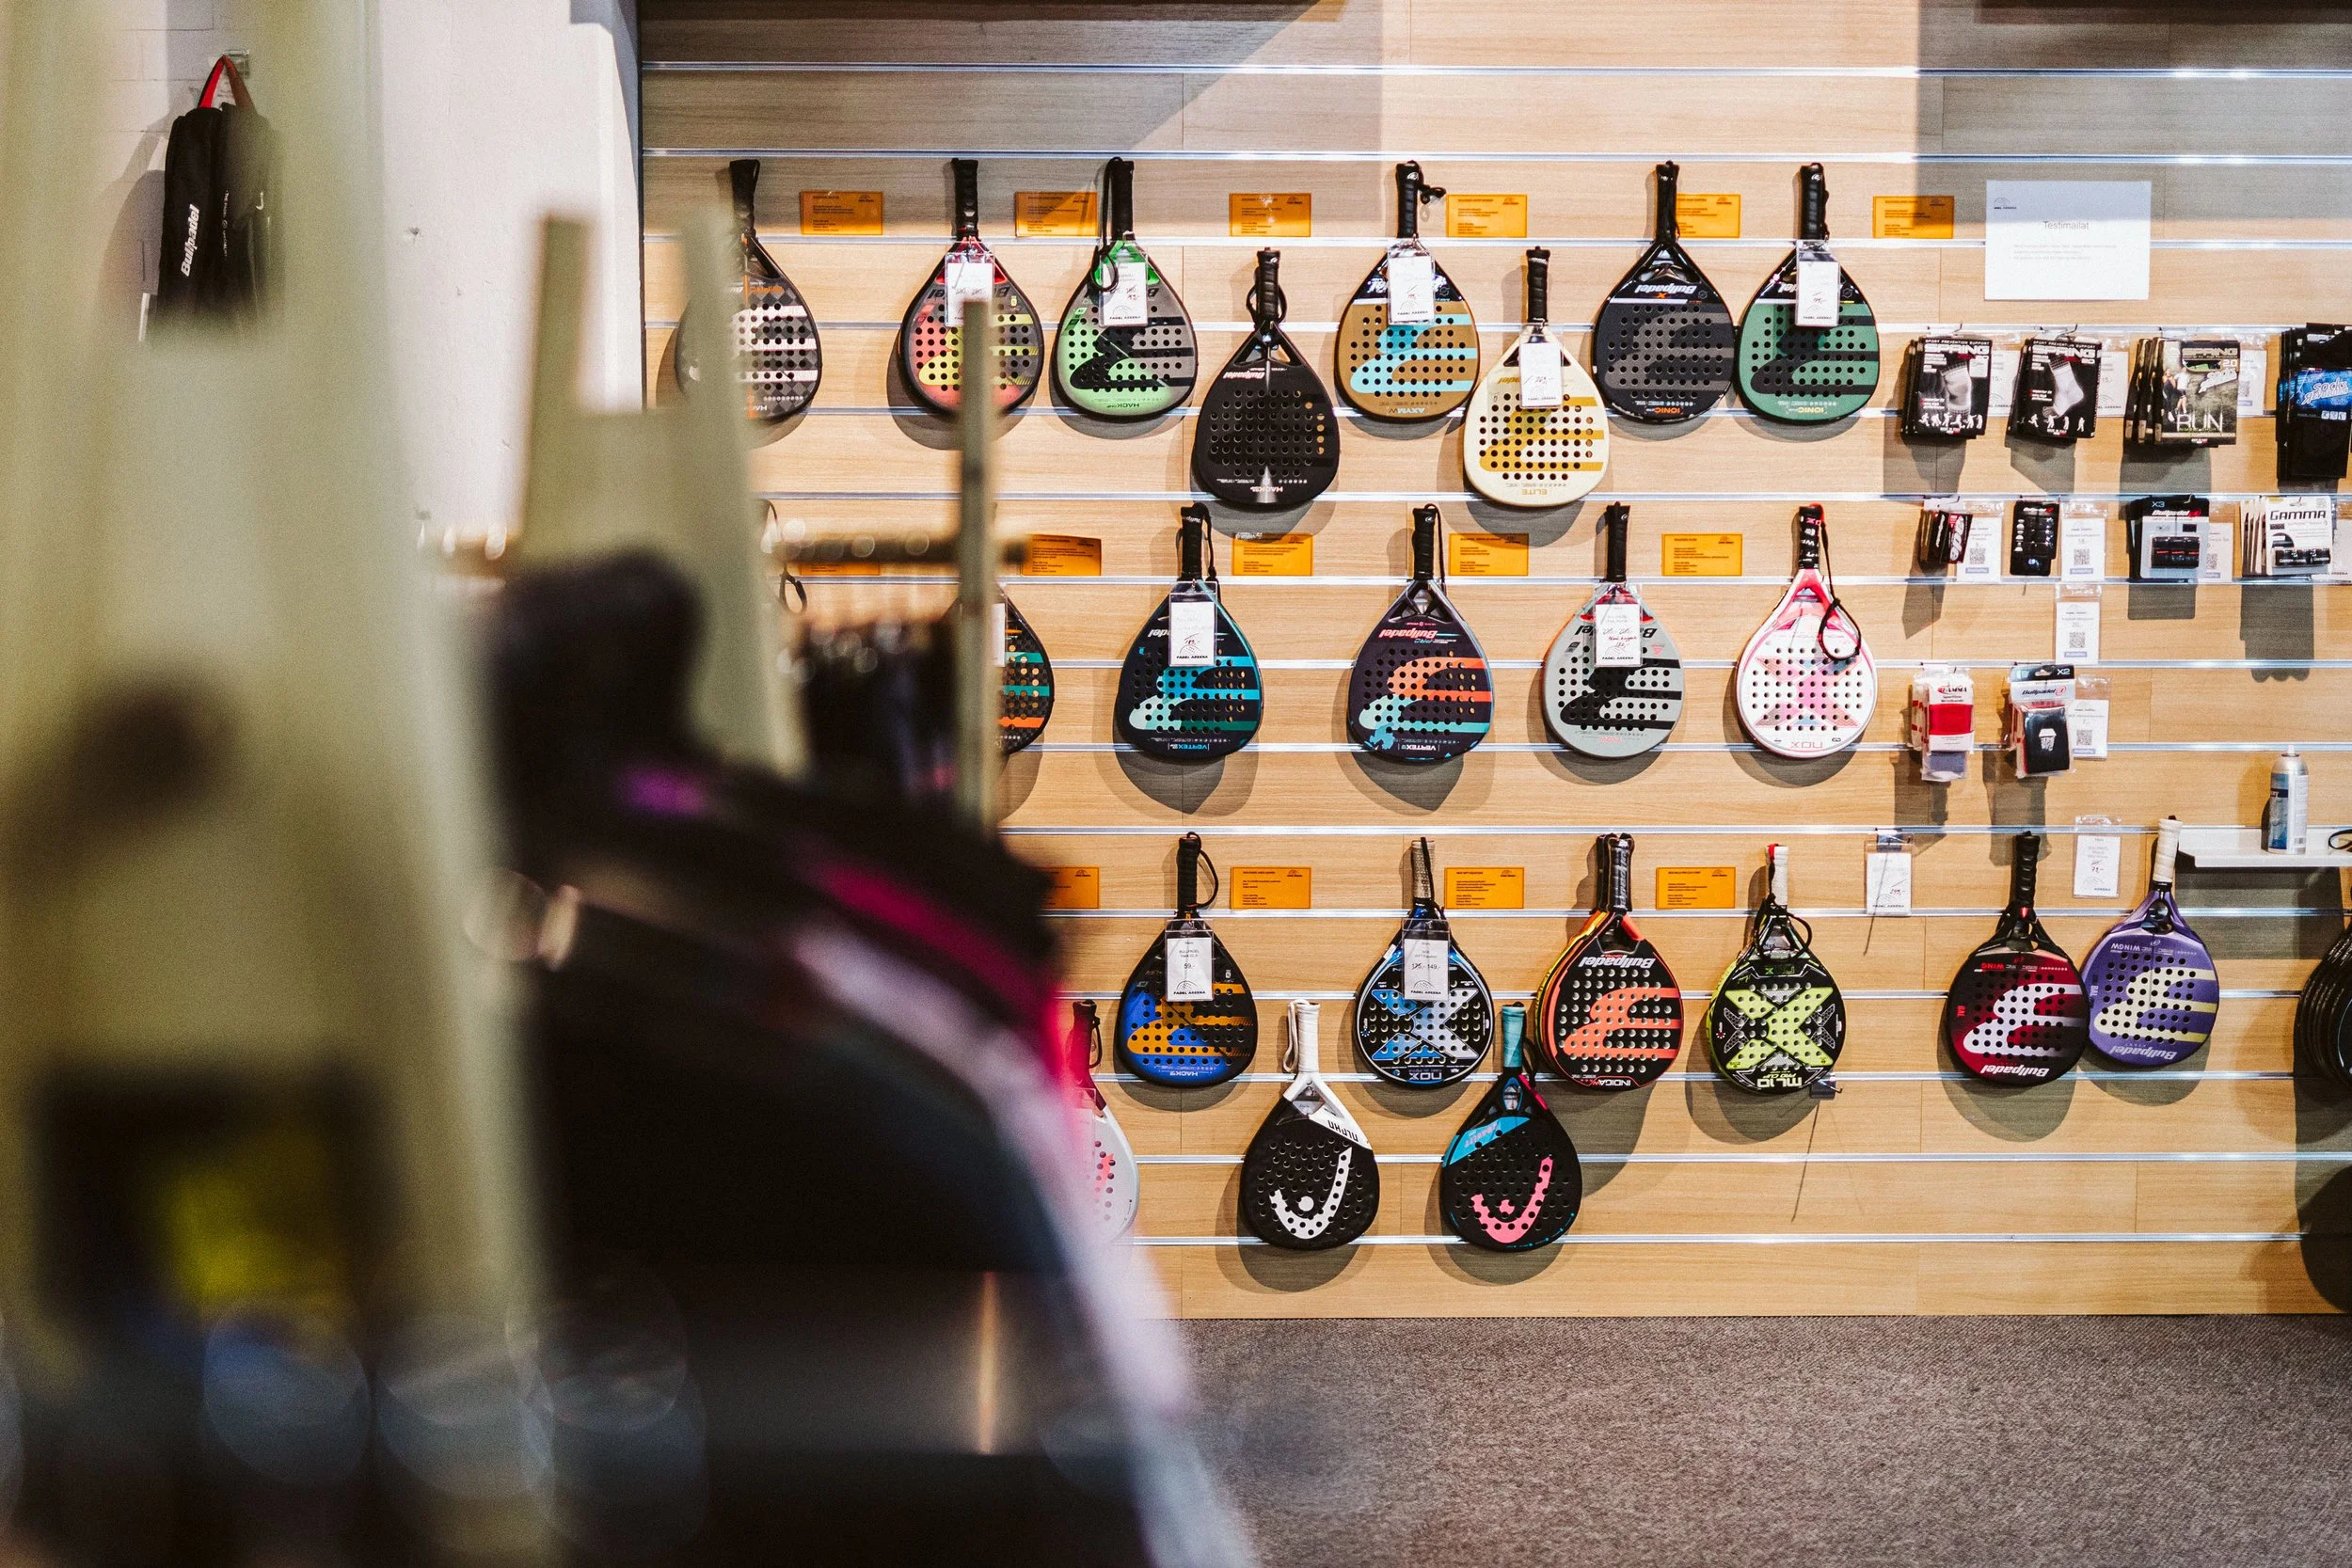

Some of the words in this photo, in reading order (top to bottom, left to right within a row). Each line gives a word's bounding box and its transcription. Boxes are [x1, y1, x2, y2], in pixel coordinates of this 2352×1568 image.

[2042, 220, 2090, 230] Testimailat
[181, 204, 199, 277] Bullpadel
[1634, 283, 1697, 294] Bullpadel
[1924, 343, 1990, 356] SPRING
[2033, 344, 2096, 357] SPRING
[1223, 370, 1265, 380] Bullpadel
[2176, 412, 2223, 433] RUN
[2151, 508, 2190, 517] Bullpadel
[2269, 509, 2327, 521] GAMMA
[1378, 627, 1438, 639] Bullpadel
[2021, 688, 2057, 697] Bullpadel
[1578, 955, 1656, 969] Bullpadel
[2090, 985, 2099, 997] BAL
[2108, 1045, 2178, 1060] Bullpadel
[1408, 1071, 1442, 1081] NOX
[1979, 1064, 2050, 1078] Bullpadel
[1756, 1076, 1803, 1088] ML10
[1327, 1119, 1359, 1143] ALPHA
